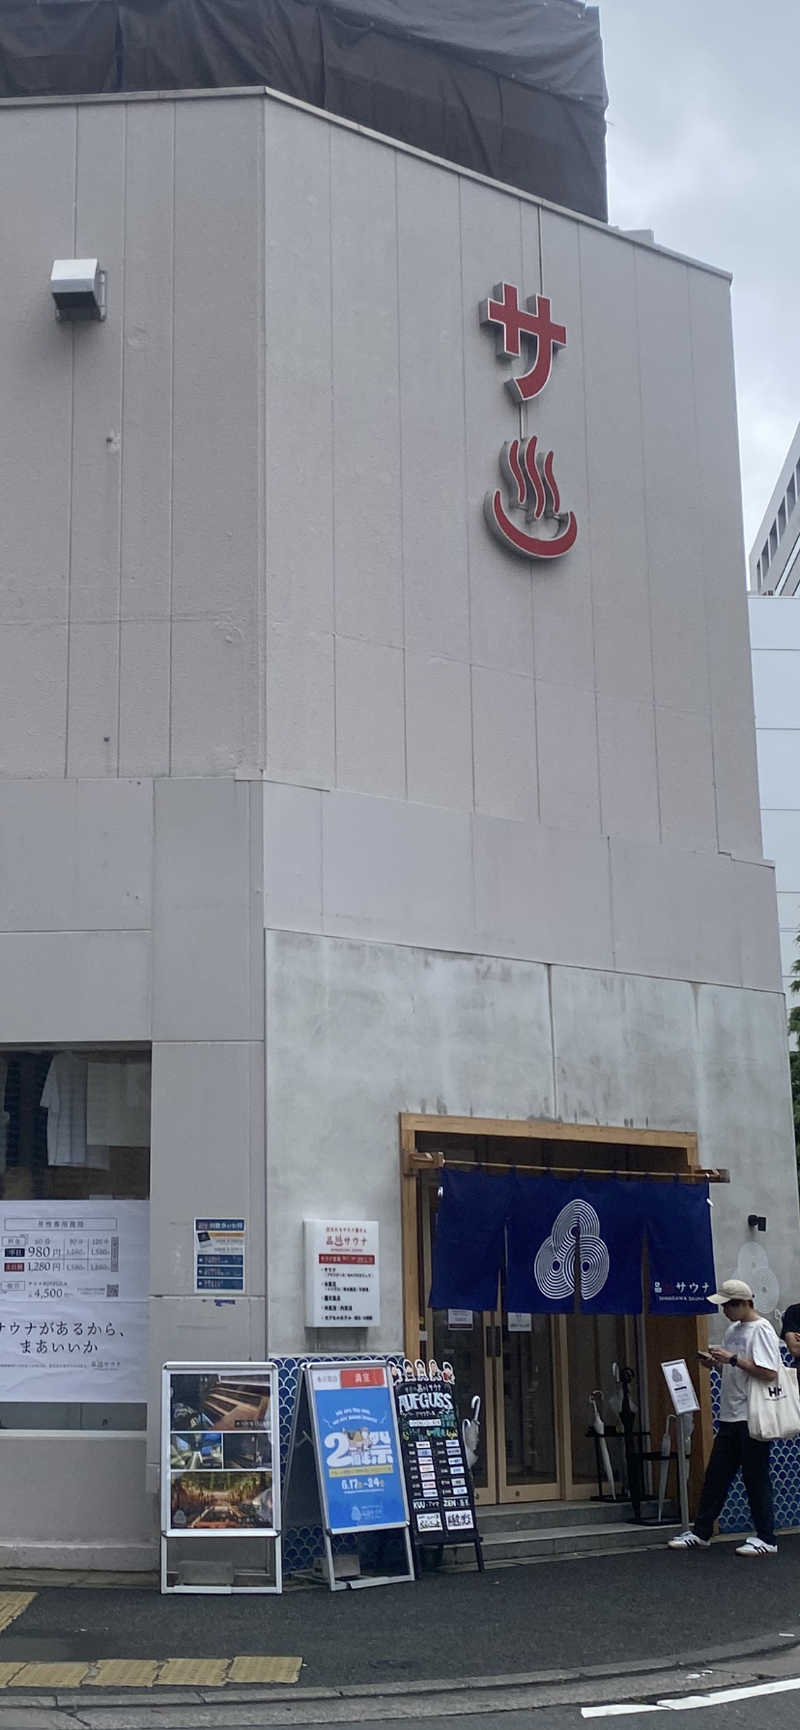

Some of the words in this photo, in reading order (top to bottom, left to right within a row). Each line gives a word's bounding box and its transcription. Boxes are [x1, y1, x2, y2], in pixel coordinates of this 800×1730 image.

[480, 281, 567, 401] サ
[654, 1281, 710, 1294] 品サウナ
[19, 1340, 98, 1354] まあいいか
[398, 1392, 454, 1414] AUFGUSS
